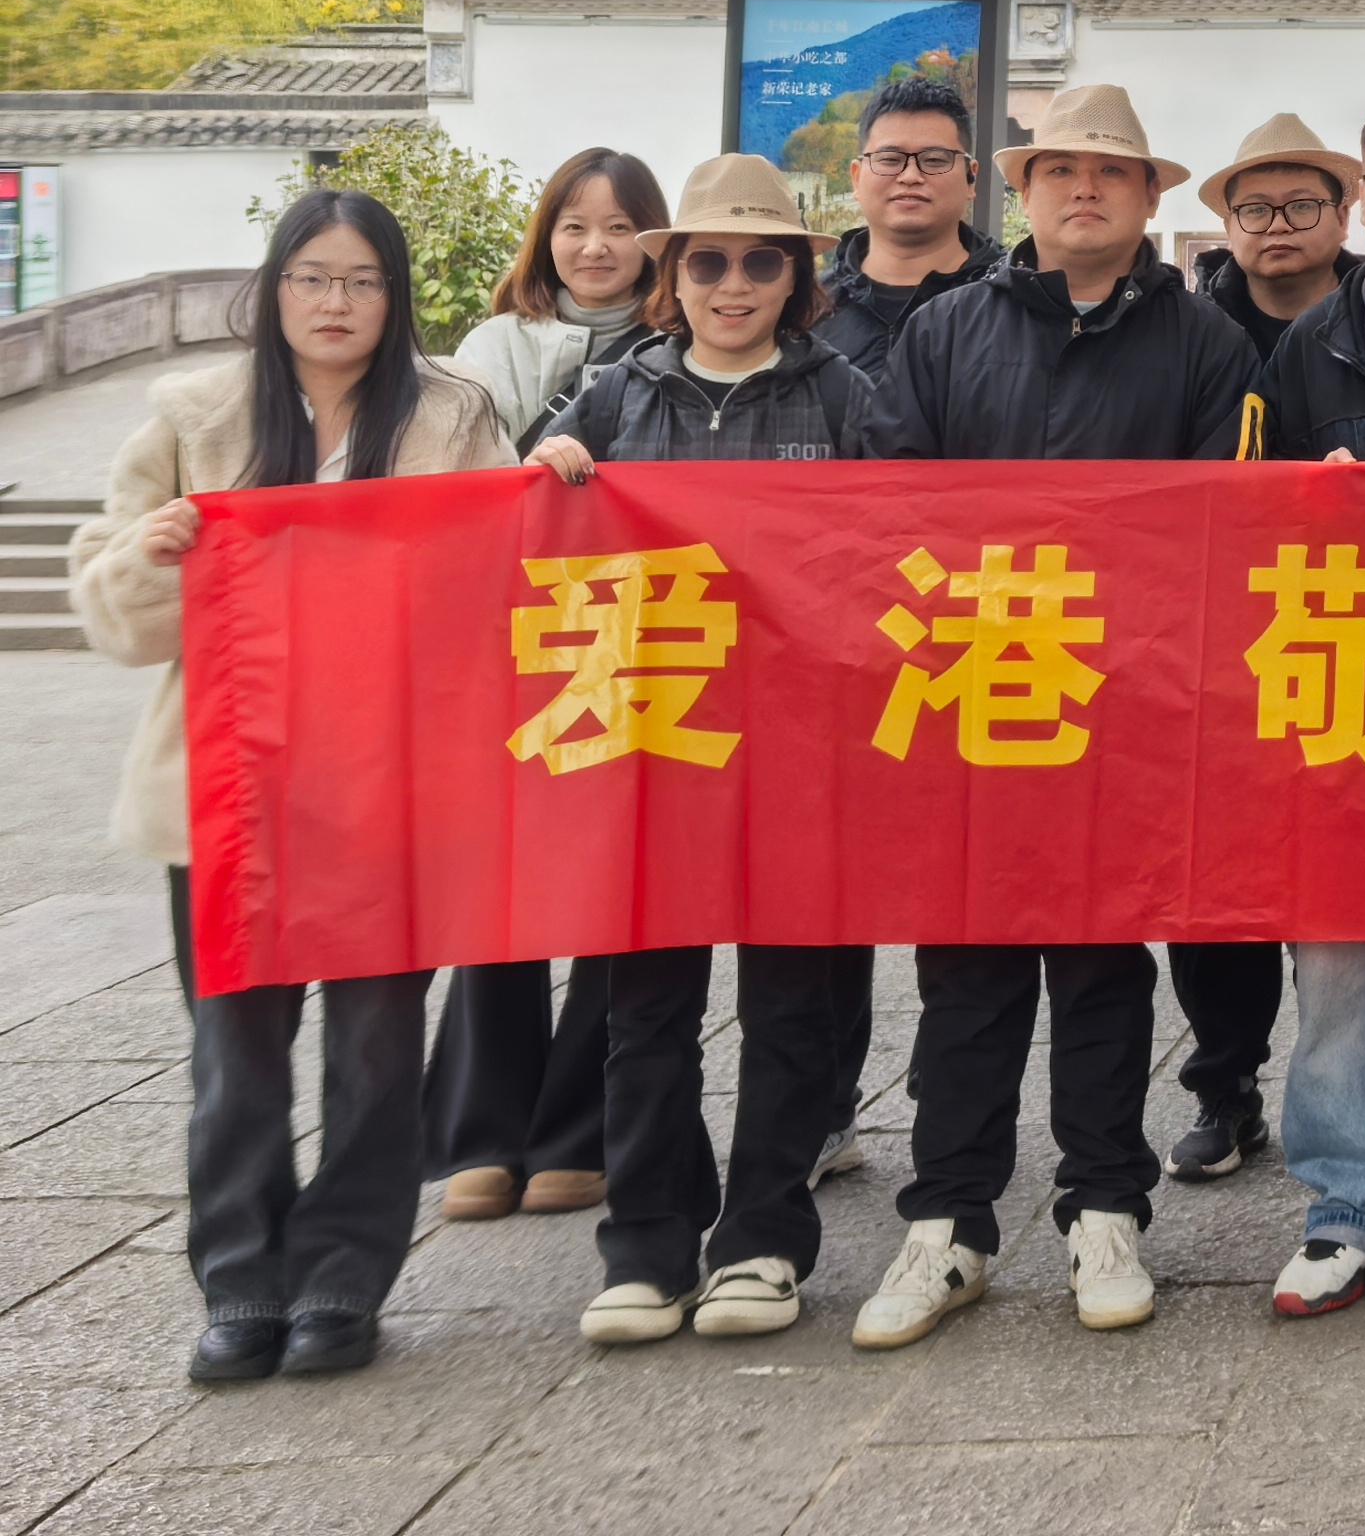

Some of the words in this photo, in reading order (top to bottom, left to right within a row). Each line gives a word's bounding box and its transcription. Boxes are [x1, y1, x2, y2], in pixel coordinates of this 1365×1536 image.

[765, 50, 849, 66] 中华小吃之都
[761, 80, 833, 97] 新荣记老家
